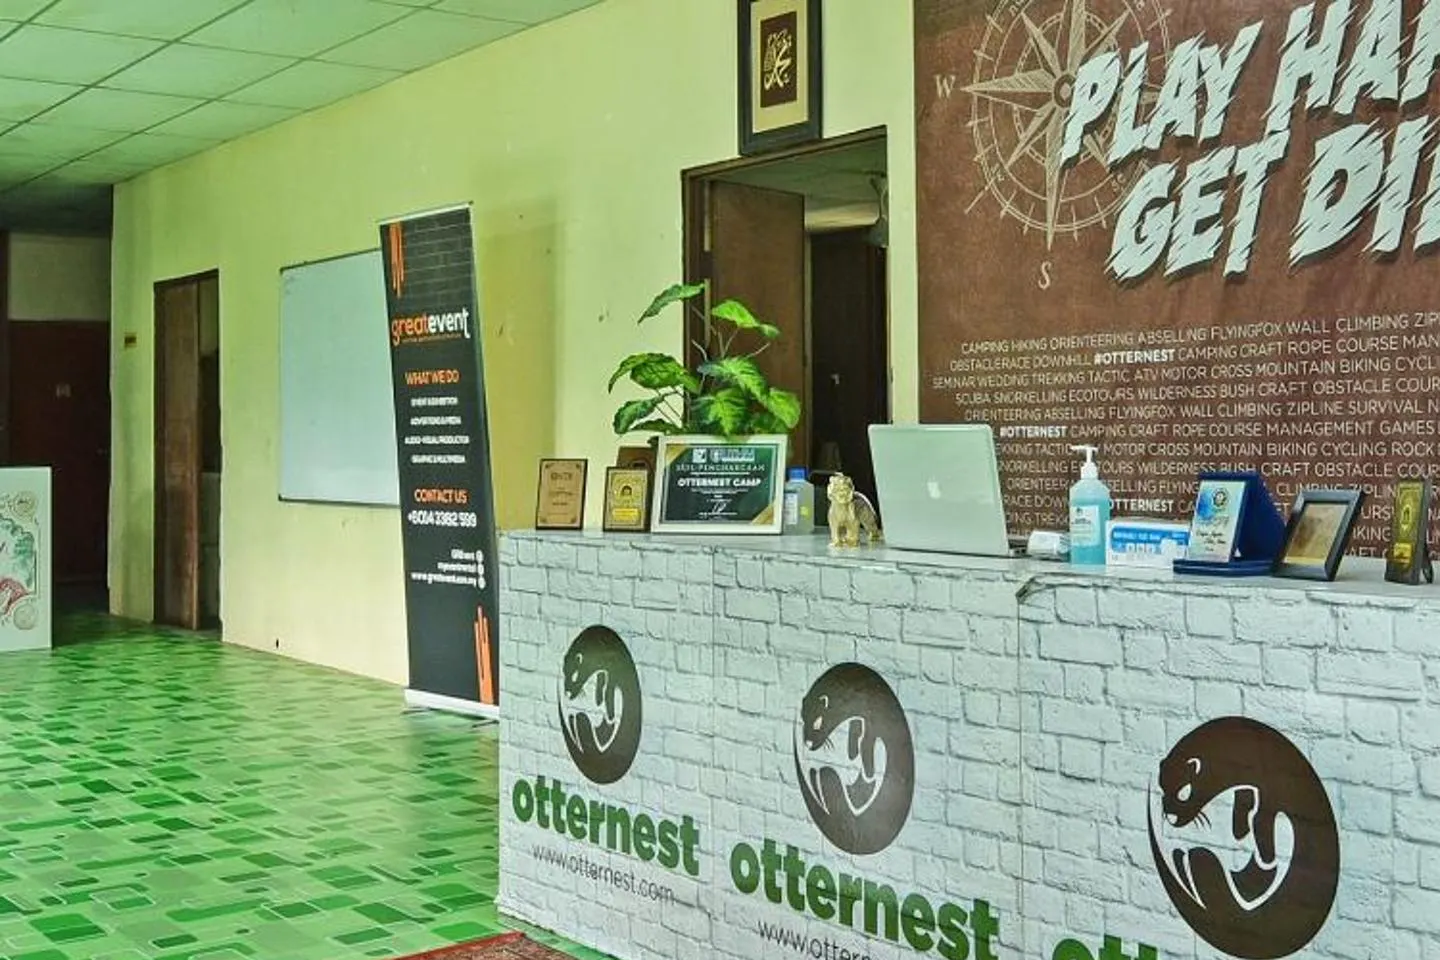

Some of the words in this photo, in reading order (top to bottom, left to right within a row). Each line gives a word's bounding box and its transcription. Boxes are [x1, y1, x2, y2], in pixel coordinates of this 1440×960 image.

[935, 74, 957, 98] W
[1058, 20, 1264, 166] PLAY
[1103, 128, 1293, 284] GET
[1037, 260, 1053, 290] S
[392, 307, 471, 347] greatevent
[1049, 332, 1133, 350] ORIENTEERING
[1138, 327, 1209, 346] ABSELLING
[1210, 321, 1284, 341] FLYINGFOX
[1286, 318, 1331, 336] WALL
[1336, 313, 1409, 333] CLIMBING
[1094, 348, 1176, 366] #OTTERNEST
[1178, 345, 1238, 361] CAMPING
[1240, 341, 1282, 358] CRAFT
[1288, 339, 1332, 356] ROPE
[1336, 335, 1398, 353] COURSE
[1088, 368, 1130, 384] TACTIC
[1134, 367, 1159, 382] ATV
[1161, 365, 1208, 381] MOTOR
[1210, 363, 1254, 379] CROSS
[1255, 359, 1336, 377] MOUNTAIN
[1339, 356, 1391, 374] BIKING
[1138, 384, 1218, 401] WILDERNESS
[1220, 383, 1256, 399] BUSH
[1257, 380, 1308, 397] CRAFT
[1312, 377, 1392, 396] OBSTACLE
[1044, 406, 1106, 421] ABSELLING
[1108, 404, 1176, 420] FLYINGFOX
[1180, 403, 1214, 419] WALL
[1216, 401, 1282, 418] CLIMBING
[1286, 400, 1344, 417] ZIPLINE
[1348, 398, 1424, 415] SURVIVAL
[1068, 424, 1126, 438] CAMPING
[1128, 423, 1168, 438] CRAFT
[1172, 423, 1206, 438] ROPE
[1208, 422, 1262, 438] COURSE
[1266, 420, 1374, 437] MANAGEMENT
[1379, 419, 1435, 435] GAMES
[1103, 442, 1146, 456] MOTOR
[1148, 442, 1188, 456] CROSS
[1192, 442, 1262, 457] MOUNTAIN
[1266, 442, 1318, 457] BIKING
[1320, 441, 1387, 457] CYCLING
[1391, 441, 1434, 457] ROCK
[1260, 461, 1311, 477] CRAFT
[1314, 461, 1393, 478] OBSTACLE
[414, 488, 453, 503] CONTACT
[455, 489, 468, 504] US
[512, 775, 701, 877] otternest
[532, 842, 676, 906] www.otternest.com
